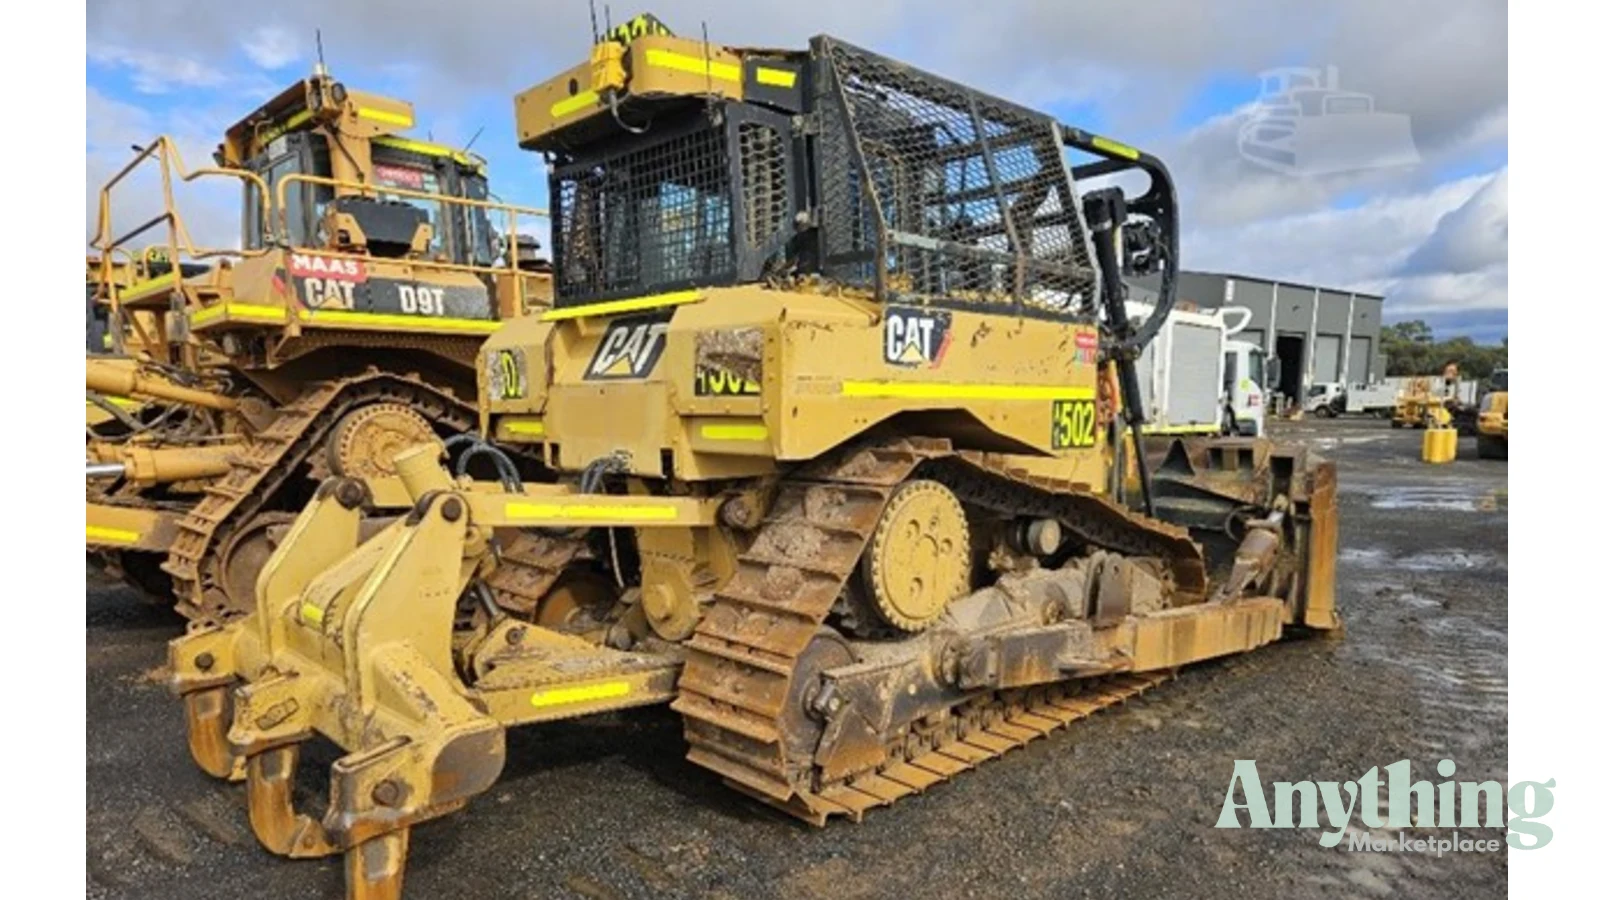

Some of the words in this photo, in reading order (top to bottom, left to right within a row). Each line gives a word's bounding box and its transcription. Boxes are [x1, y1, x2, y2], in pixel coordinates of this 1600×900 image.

[291, 254, 358, 275] MAAS
[304, 278, 355, 309] CAT
[399, 285, 444, 315] D9T
[591, 322, 669, 376] CAT
[887, 314, 935, 361] CAT
[1060, 402, 1094, 446] 502
